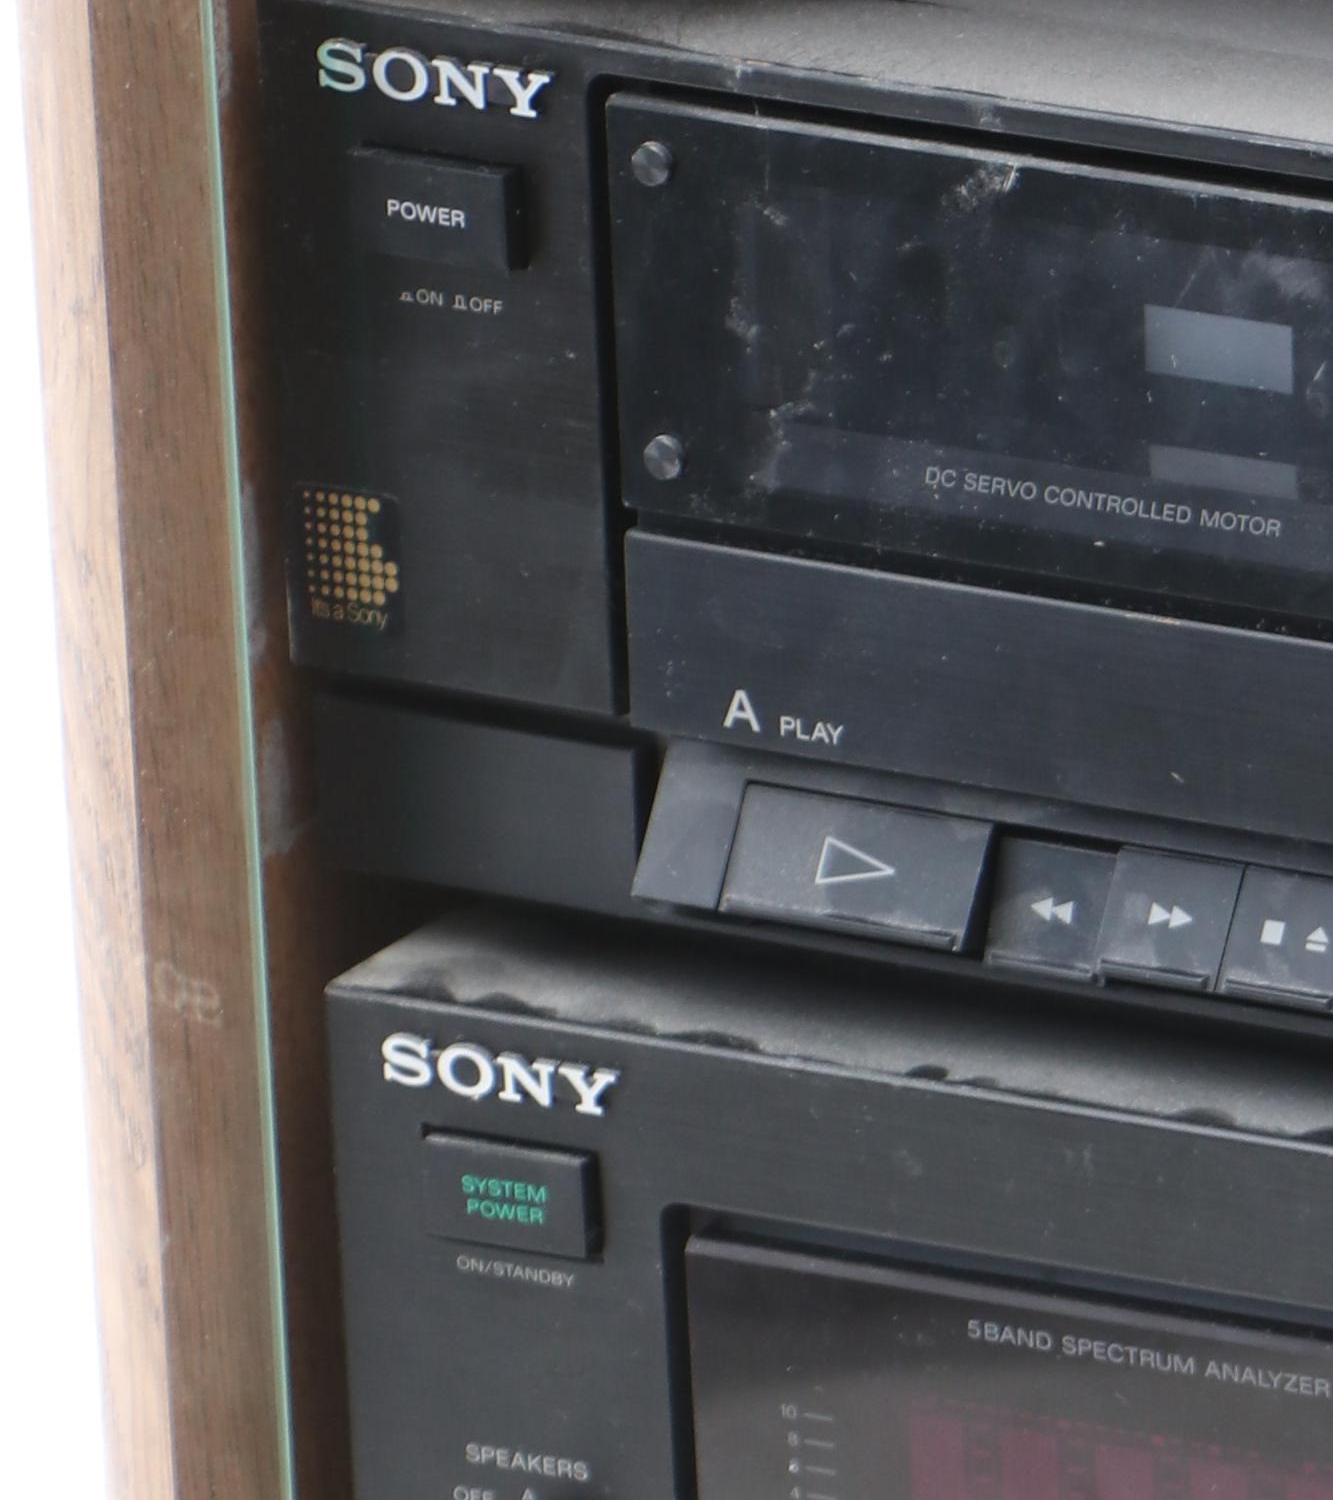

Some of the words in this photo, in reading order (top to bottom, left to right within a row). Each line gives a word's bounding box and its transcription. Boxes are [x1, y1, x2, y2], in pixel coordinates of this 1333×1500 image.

[317, 37, 553, 118] SONY
[387, 200, 465, 227] POWER
[924, 466, 956, 488] DC
[964, 472, 1037, 500] SERVO
[1043, 485, 1192, 524] CONTROLLED
[1200, 509, 1282, 538] MOTOR
[723, 690, 759, 733] A
[780, 717, 843, 745] PLAY
[382, 1033, 620, 1117] SONY
[461, 1173, 547, 1202] SYSTEM
[467, 1199, 544, 1225] POWER
[456, 1255, 576, 1287] ON/STANDBY
[1062, 1336, 1196, 1376] SPECTRUM
[1205, 1359, 1332, 1398] ANALYZER
[466, 1443, 589, 1481] SPEAKERS
